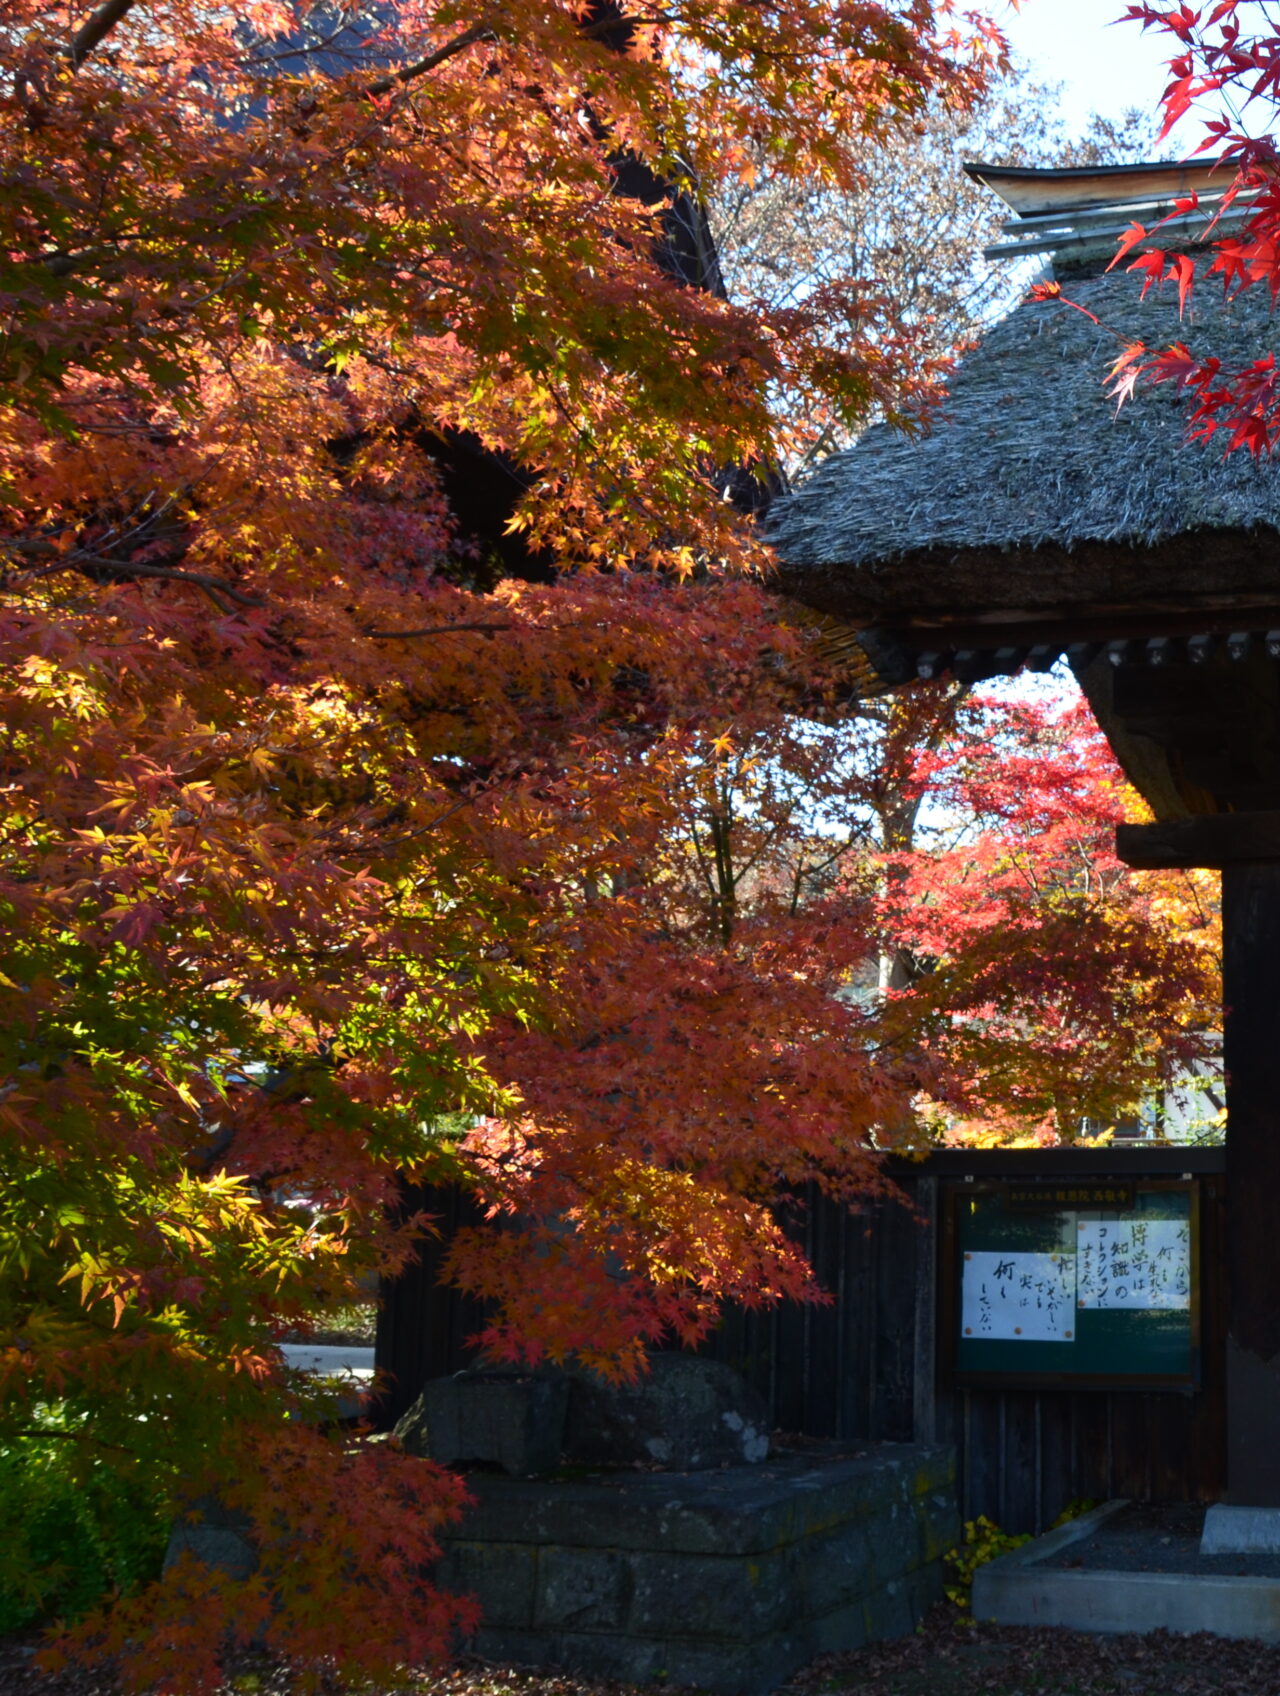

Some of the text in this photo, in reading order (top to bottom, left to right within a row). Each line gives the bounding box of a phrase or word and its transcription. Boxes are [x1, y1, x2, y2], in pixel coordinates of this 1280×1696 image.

[1056, 1255, 1073, 1300] 忙しい
[1097, 1227, 1109, 1308] コレクションに
[1109, 1241, 1129, 1299] 知識の
[1131, 1221, 1149, 1291] 博学は
[1175, 1228, 1190, 1296] そこから
[978, 1282, 993, 1332] していない
[1018, 1272, 1033, 1308] 実は
[1033, 1281, 1047, 1310] でも
